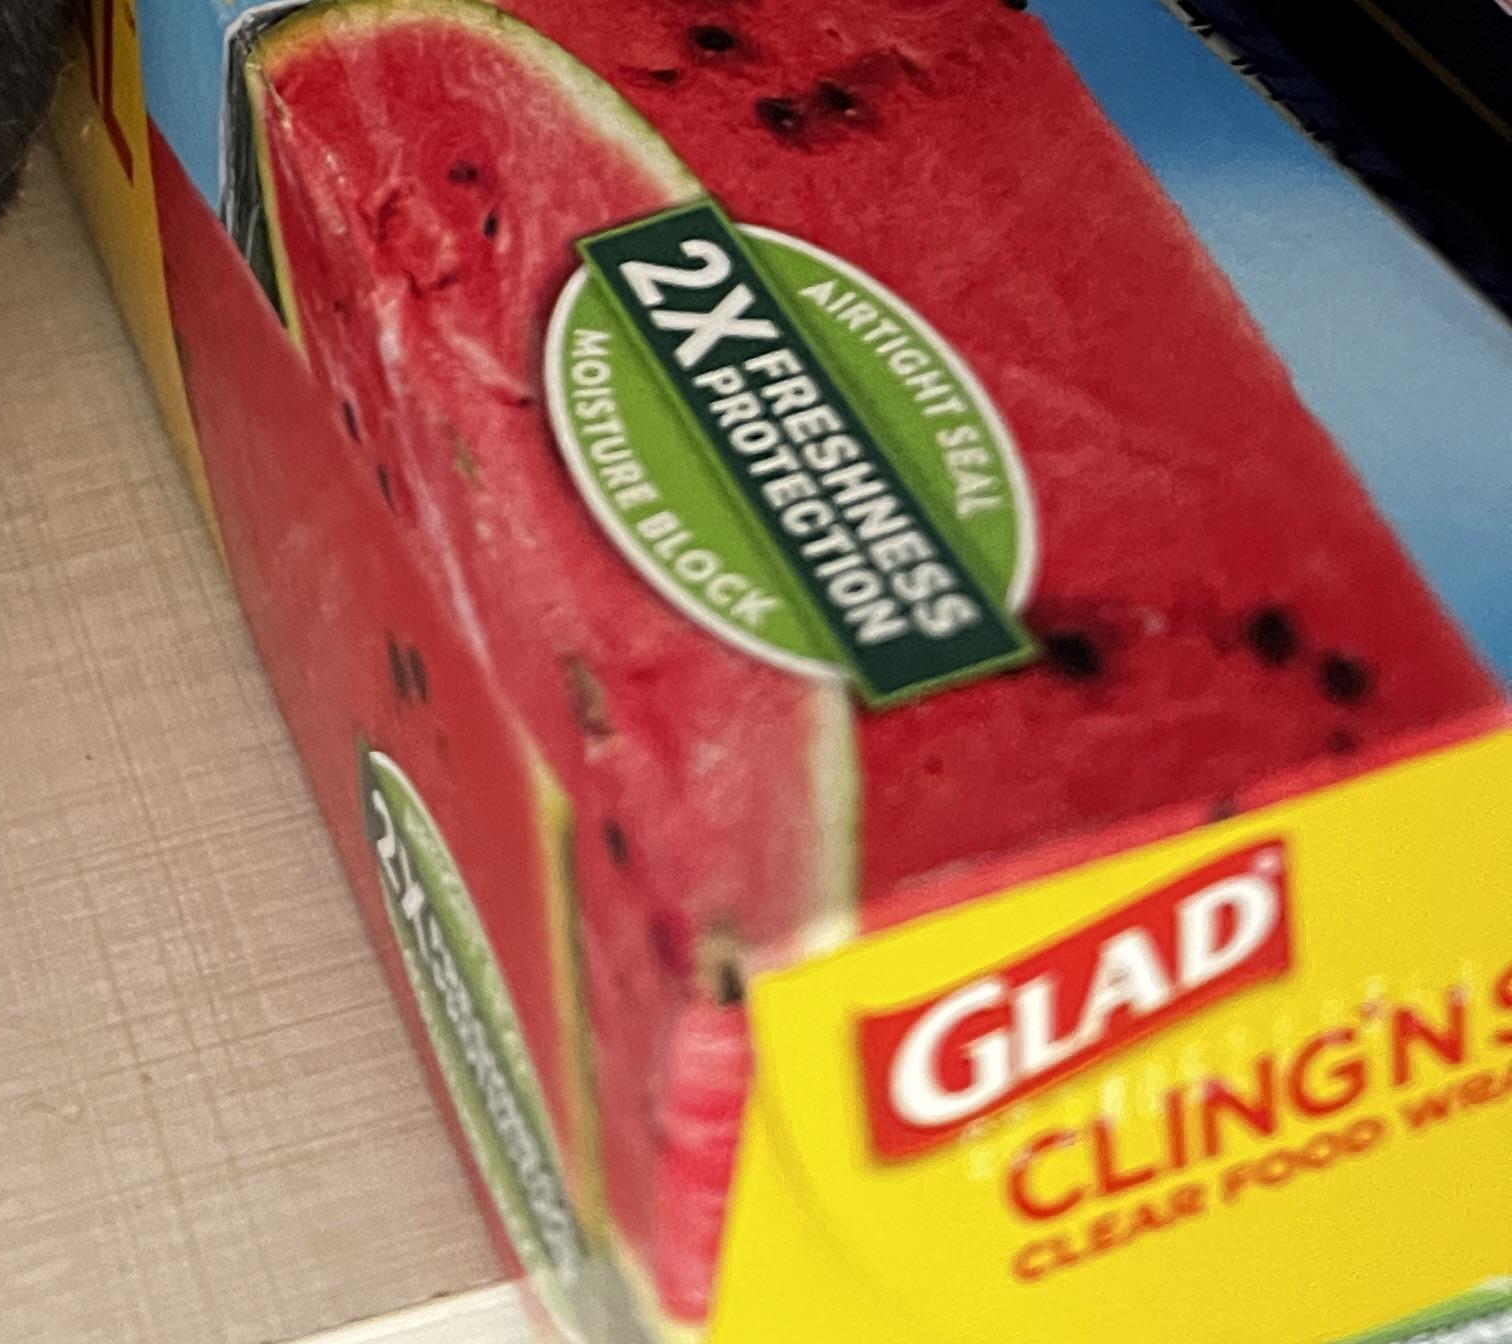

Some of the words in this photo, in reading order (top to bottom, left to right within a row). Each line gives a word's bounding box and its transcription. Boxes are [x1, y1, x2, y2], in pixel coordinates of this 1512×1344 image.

[571, 327, 660, 512] MOISTURE
[636, 510, 784, 629] BLOCK
[618, 237, 779, 368] 2X
[745, 348, 981, 639] FRESHNESS
[694, 367, 910, 646] PROTECTION
[800, 278, 966, 420] AIRTIGHT
[936, 423, 1005, 521] SEAL
[1011, 1185, 1206, 1283] CLEAR
[1221, 1117, 1387, 1204] FOOD
